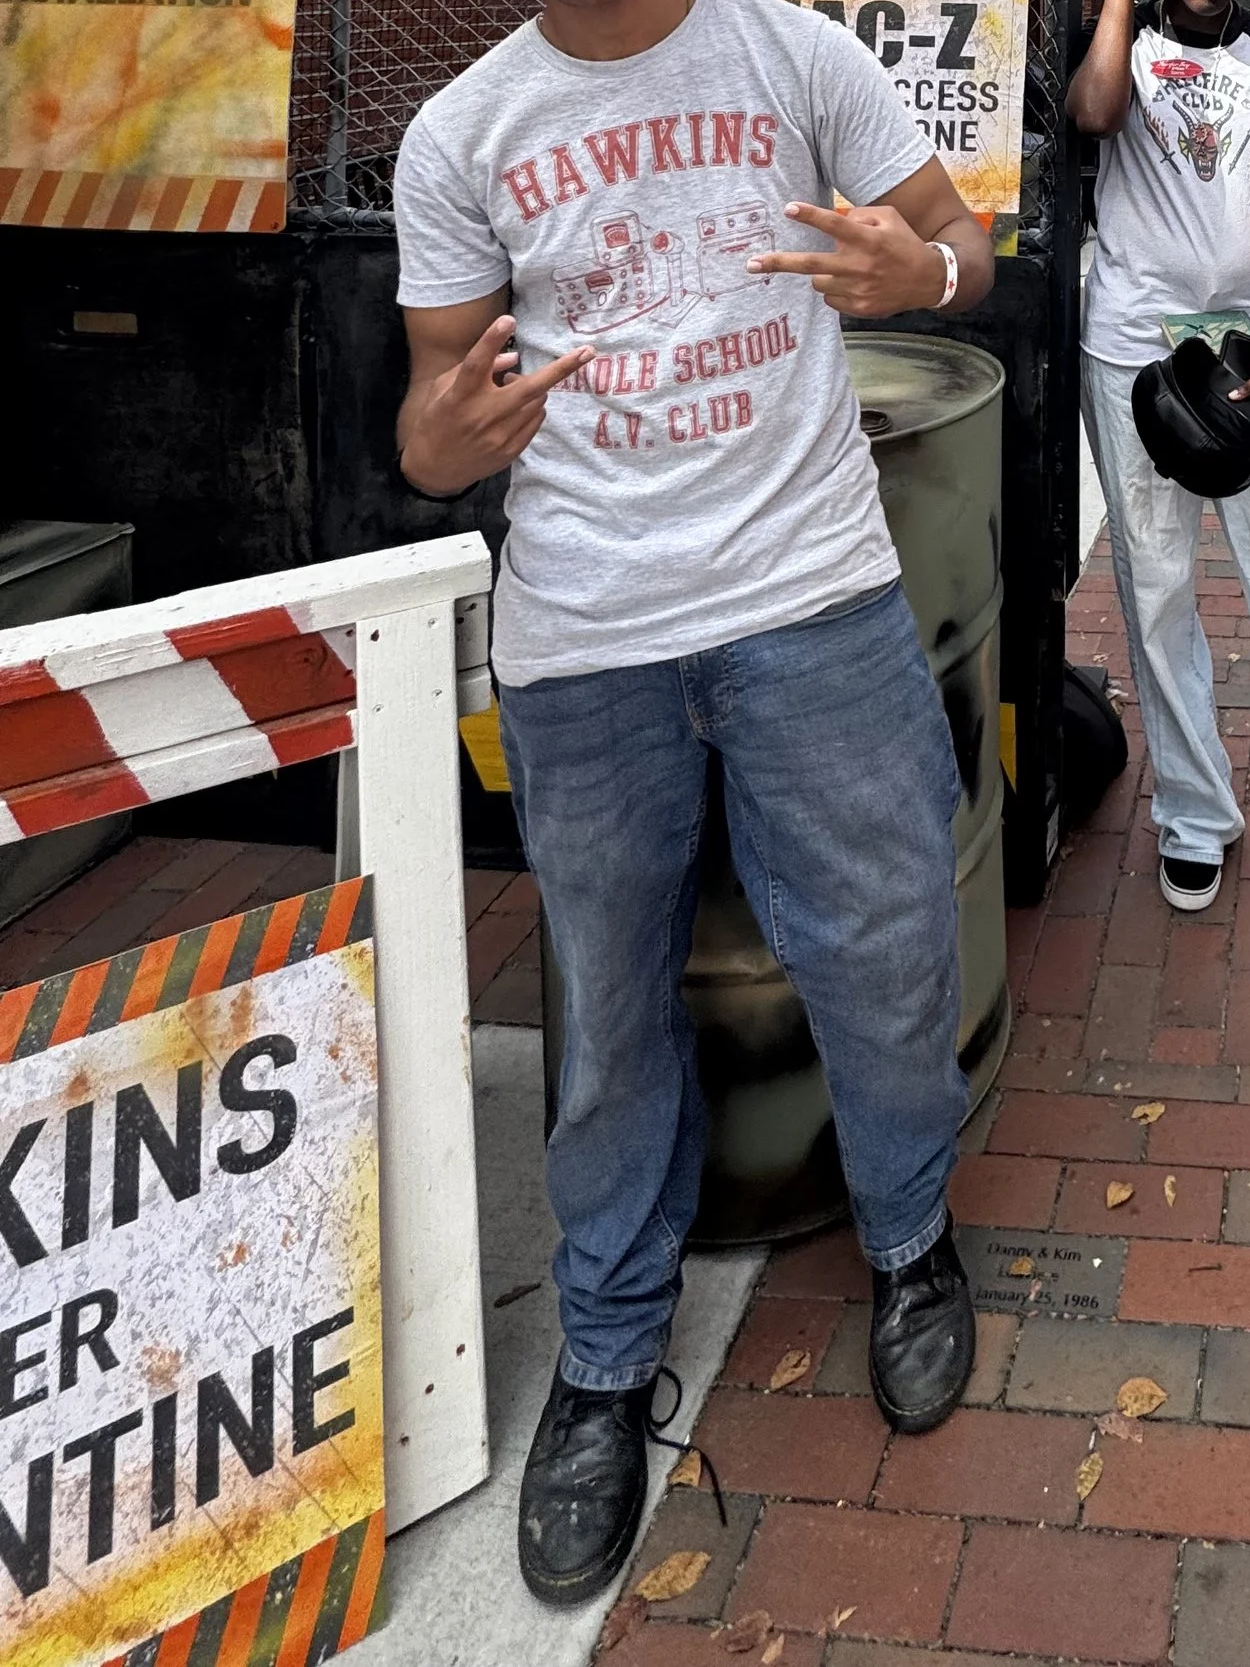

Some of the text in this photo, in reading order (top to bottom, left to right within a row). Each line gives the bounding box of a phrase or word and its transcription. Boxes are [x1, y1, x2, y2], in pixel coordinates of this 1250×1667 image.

[1182, 92, 1224, 111] CLUB
[502, 110, 779, 224] HAWKINS
[672, 312, 798, 385] SCHOOL
[593, 389, 754, 450] A.V. CLUB
[986, 1241, 1082, 1262] Danny & Kim
[974, 1287, 1029, 1306] January
[1064, 1293, 1100, 1309] 1986
